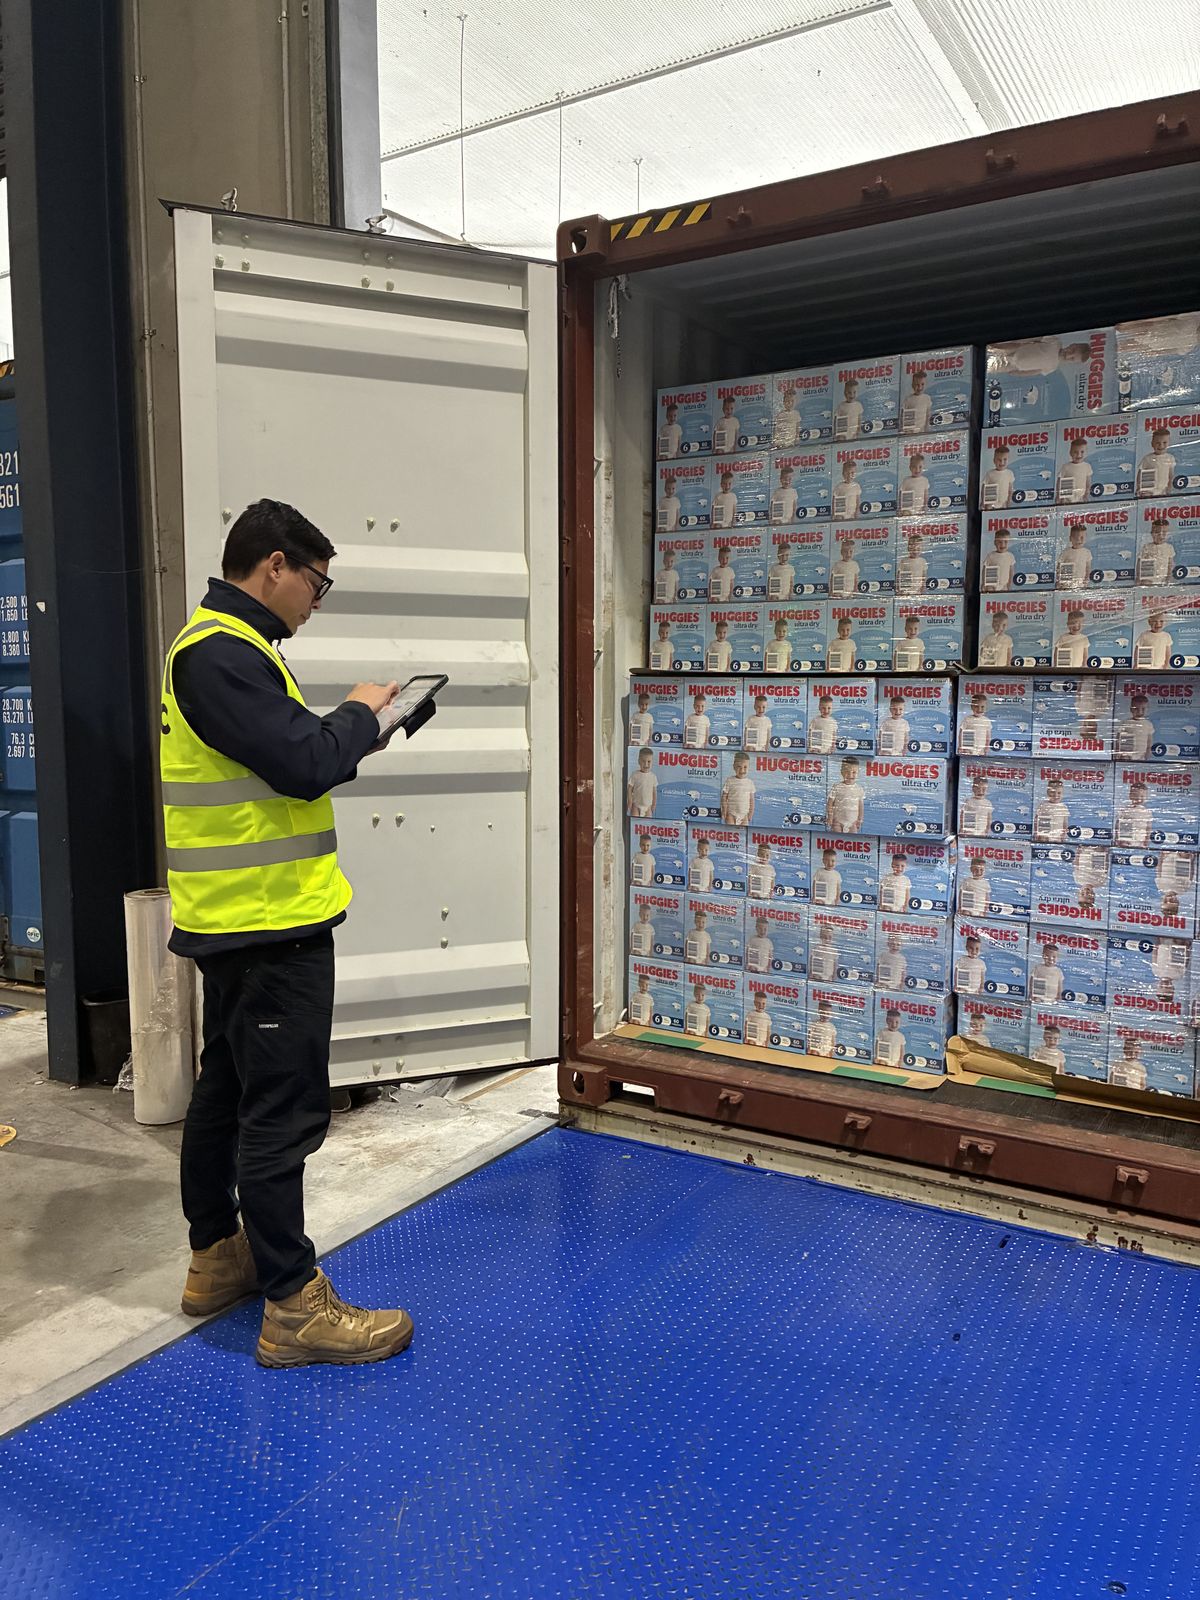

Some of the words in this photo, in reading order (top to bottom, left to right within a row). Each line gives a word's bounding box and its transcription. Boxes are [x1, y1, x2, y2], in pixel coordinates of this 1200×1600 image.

[907, 356, 963, 376] HUGGIES
[1086, 333, 1107, 411] HUGGIES
[839, 365, 893, 382] HUGGIES
[780, 375, 828, 392] HUGGIES
[662, 392, 706, 404] HUGGIES
[718, 383, 765, 399] HUGGIES
[1064, 423, 1129, 441] HUGGIES
[988, 432, 1049, 449] HUGGIES
[904, 440, 959, 457] HUGGIES
[1036, 445, 1048, 453] dry
[775, 456, 825, 469] HUGGIES
[837, 448, 890, 464] HUGGIES
[661, 467, 705, 479] HUGGIES
[716, 461, 763, 474] HUGGIES
[1093, 485, 1100, 494] 6
[988, 516, 1048, 531] HUGGIES
[1064, 511, 1129, 527] HUGGIES
[902, 523, 959, 537] HUGGIES
[1115, 523, 1128, 531] dry
[771, 532, 822, 544] HUGGIES
[836, 527, 889, 542] HUGGIES
[659, 541, 704, 552] HUGGIES
[713, 536, 761, 548] HUGGIES
[1016, 575, 1022, 583] 6
[1093, 572, 1099, 580] 6
[21, 595, 28, 607] K
[985, 601, 1047, 613] HUGGIES
[1061, 599, 1125, 613] HUGGIES
[654, 611, 699, 623] HUGGIES
[710, 611, 758, 623] HUGGIES
[769, 610, 820, 622] HUGGIES
[832, 607, 886, 620] HUGGIES
[900, 605, 956, 618] HUGGIES
[2, 631, 19, 644] 3.800
[23, 630, 29, 642] K
[2, 643, 20, 656] 8.380
[858, 661, 863, 670] 6
[1014, 658, 1020, 666] 6
[1091, 658, 1097, 666] 6
[634, 684, 678, 695] HUGGIES
[688, 685, 736, 697] HUGGIES
[749, 684, 799, 698] HUGGIES
[813, 685, 867, 698] HUGGIES
[884, 685, 941, 699] HUGGIES
[965, 683, 1026, 696] HUGGIES
[1124, 683, 1193, 698] HUGGIES
[2, 698, 24, 711] 28.700
[2, 711, 24, 723] 63.270
[11, 733, 25, 745] 76.3
[911, 742, 916, 750] 6
[1039, 738, 1104, 752] HUGGIES
[8, 745, 25, 758] 2.697
[658, 752, 718, 769] HUGGIES
[756, 757, 822, 774] HUGGIES
[706, 769, 717, 777] dry
[866, 761, 940, 779] HUGGIES
[966, 766, 1026, 780] HUGGIES
[1041, 769, 1104, 784] HUGGIES
[808, 775, 822, 783] dry
[923, 780, 938, 789] dry
[1122, 771, 1191, 786] HUGGIES
[635, 825, 679, 838] HUGGIES
[692, 828, 739, 843] HUGGIES
[752, 833, 803, 848] HUGGIES
[816, 838, 870, 853] HUGGIES
[886, 842, 945, 858] HUGGIES
[964, 846, 1024, 862] HUGGIES
[635, 894, 679, 909] HUGGIES
[843, 893, 849, 901] 6
[689, 900, 737, 916] HUGGIES
[751, 907, 800, 922] HUGGIES
[1038, 903, 1102, 921] HUGGIES
[814, 913, 868, 931] HUGGIES
[1117, 910, 1186, 929] HUGGIES
[882, 920, 938, 938] HUGGIES
[959, 926, 1018, 942] HUGGIES
[1036, 932, 1099, 950] HUGGIES
[634, 963, 679, 980] HUGGIES
[688, 973, 736, 990] HUGGIES
[749, 980, 798, 998] HUGGIES
[813, 990, 866, 1009] HUGGIES
[1114, 994, 1181, 1016] HUGGIES
[880, 999, 935, 1017] HUGGIES
[964, 1001, 1023, 1020] HUGGIES
[1037, 1014, 1101, 1033] HUGGIES
[1117, 1026, 1184, 1046] HUGGIES
